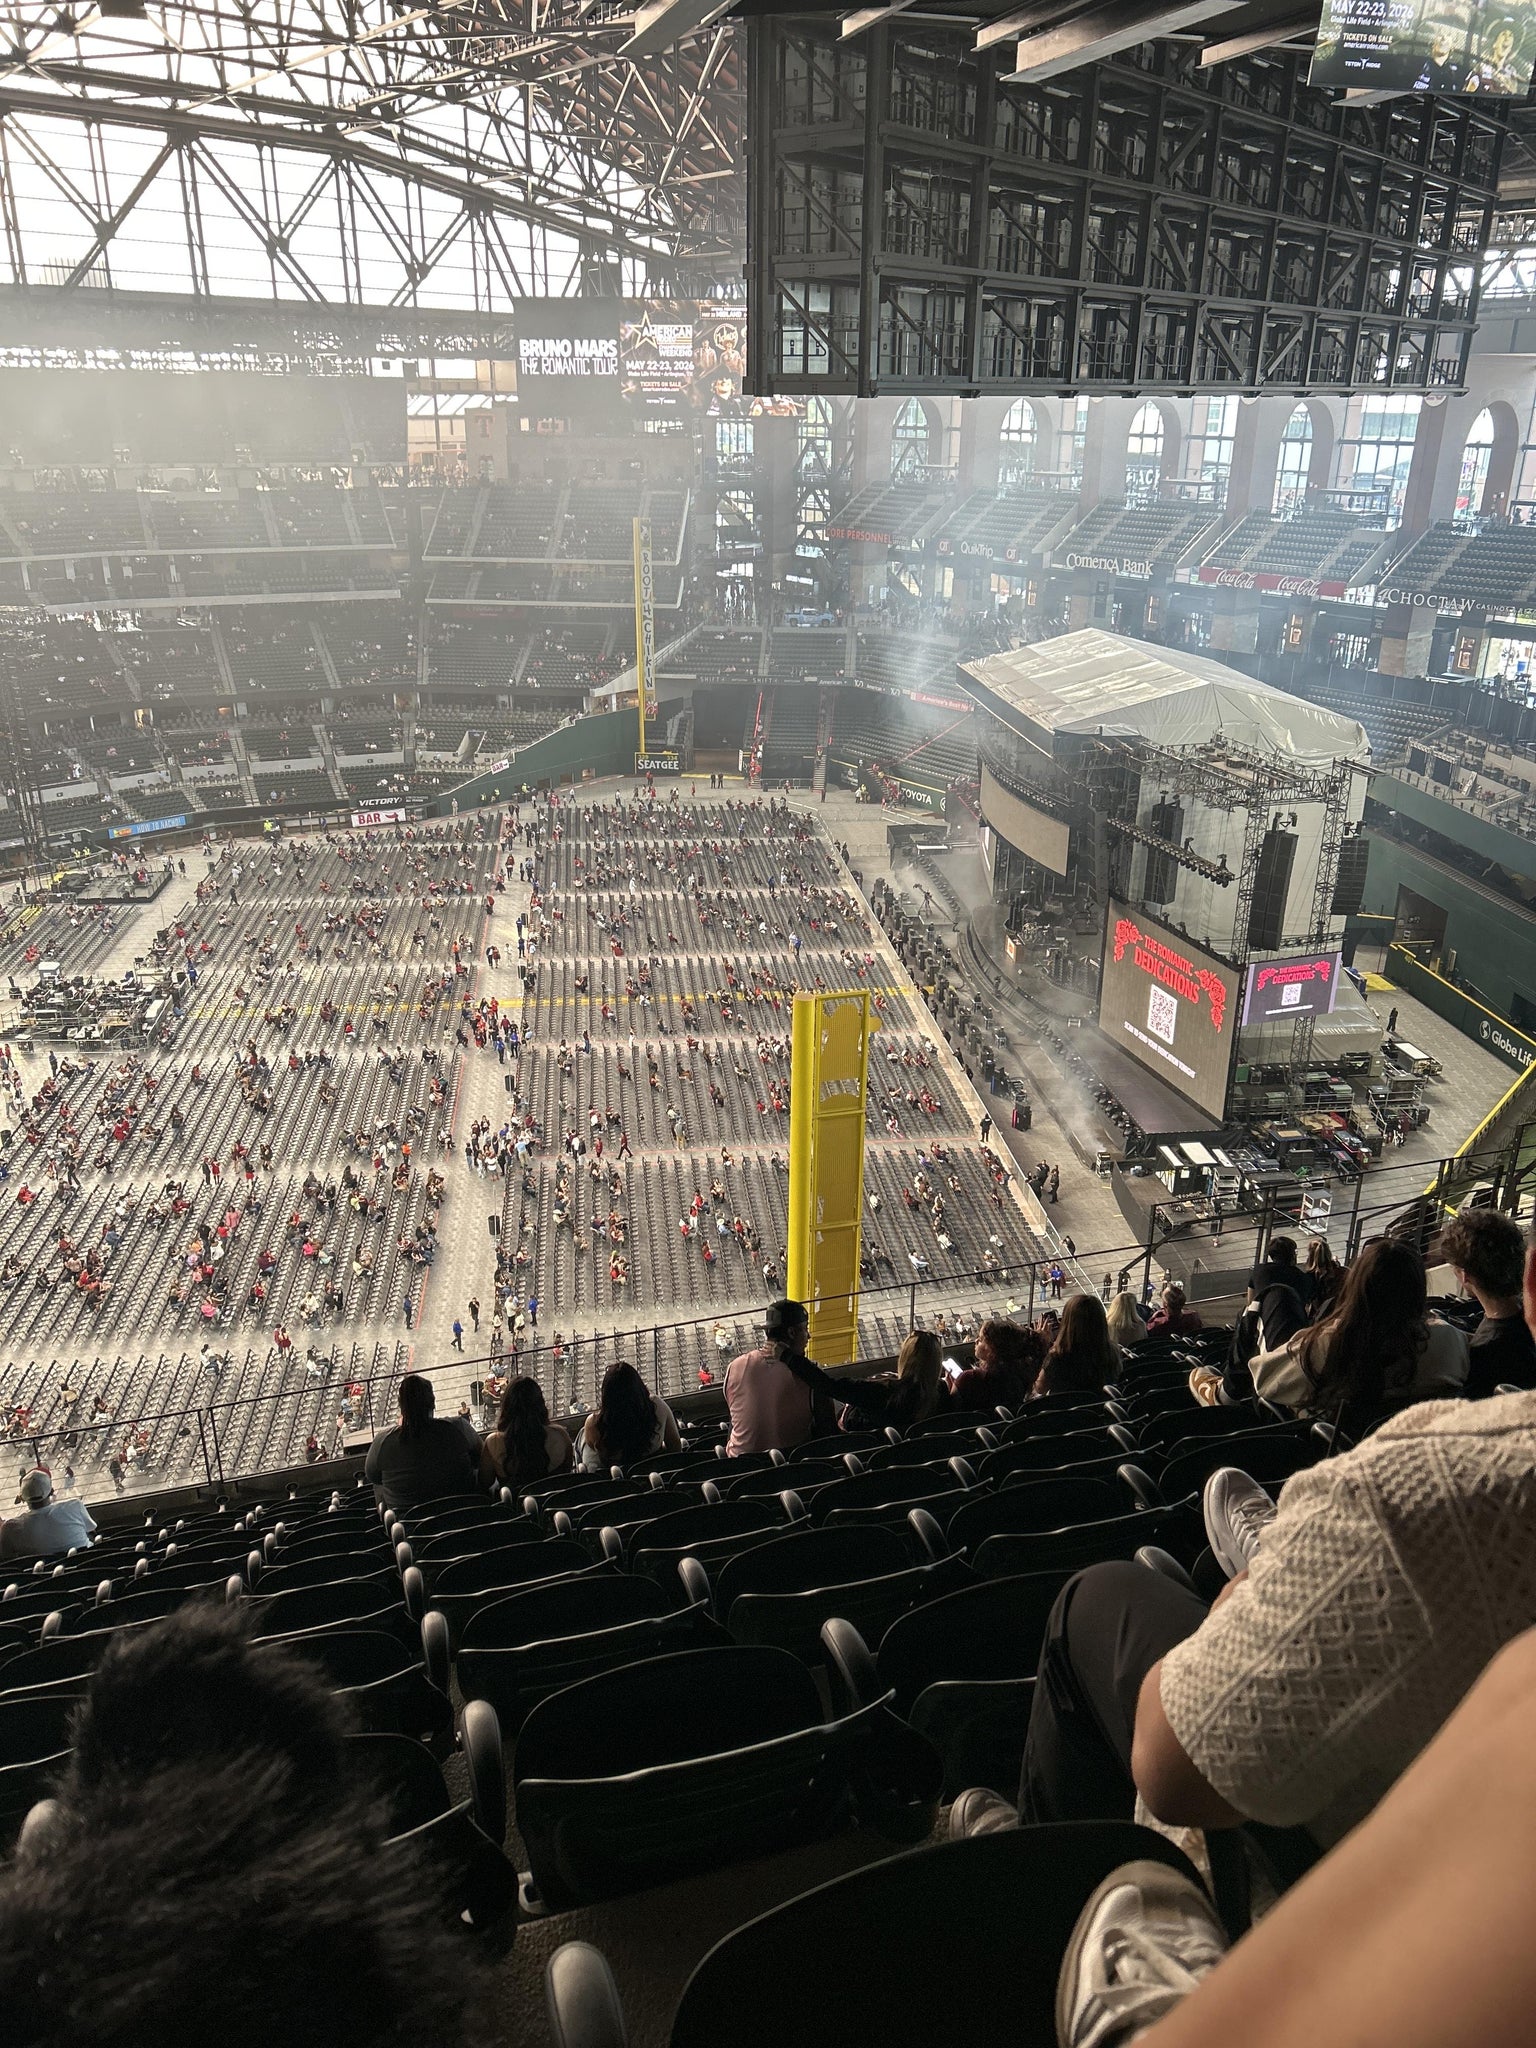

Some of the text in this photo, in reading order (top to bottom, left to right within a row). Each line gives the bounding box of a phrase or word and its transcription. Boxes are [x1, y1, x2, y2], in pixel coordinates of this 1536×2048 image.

[1330, 0, 1414, 19] MAY 22-23, 2026
[1357, 17, 1370, 26] Field
[1343, 33, 1393, 43] TICKETS ON SALE
[641, 325, 693, 337] AMERICAN
[519, 339, 618, 358] BRUNO MARS
[519, 357, 618, 375] THE ROMANTIC TOUR
[626, 361, 694, 371] MAY 22-23, 2026
[847, 530, 892, 544] PERSONNEL
[960, 541, 994, 559] QuikTrip
[642, 553, 651, 598] ROOT
[1122, 558, 1154, 575] Bank
[1388, 588, 1476, 612] CHOCTAW
[644, 623, 653, 689] CHIKIN
[492, 763, 504, 772] BAR
[358, 797, 401, 806] VICTORY
[901, 787, 932, 805] TOYOTA
[358, 813, 381, 825] BAR
[1144, 934, 1194, 977] THE ROMANTIC
[1134, 945, 1200, 1004] DEDICATIONS
[1272, 970, 1316, 985] DEDICATIONS
[1491, 1030, 1518, 1058] Globe
